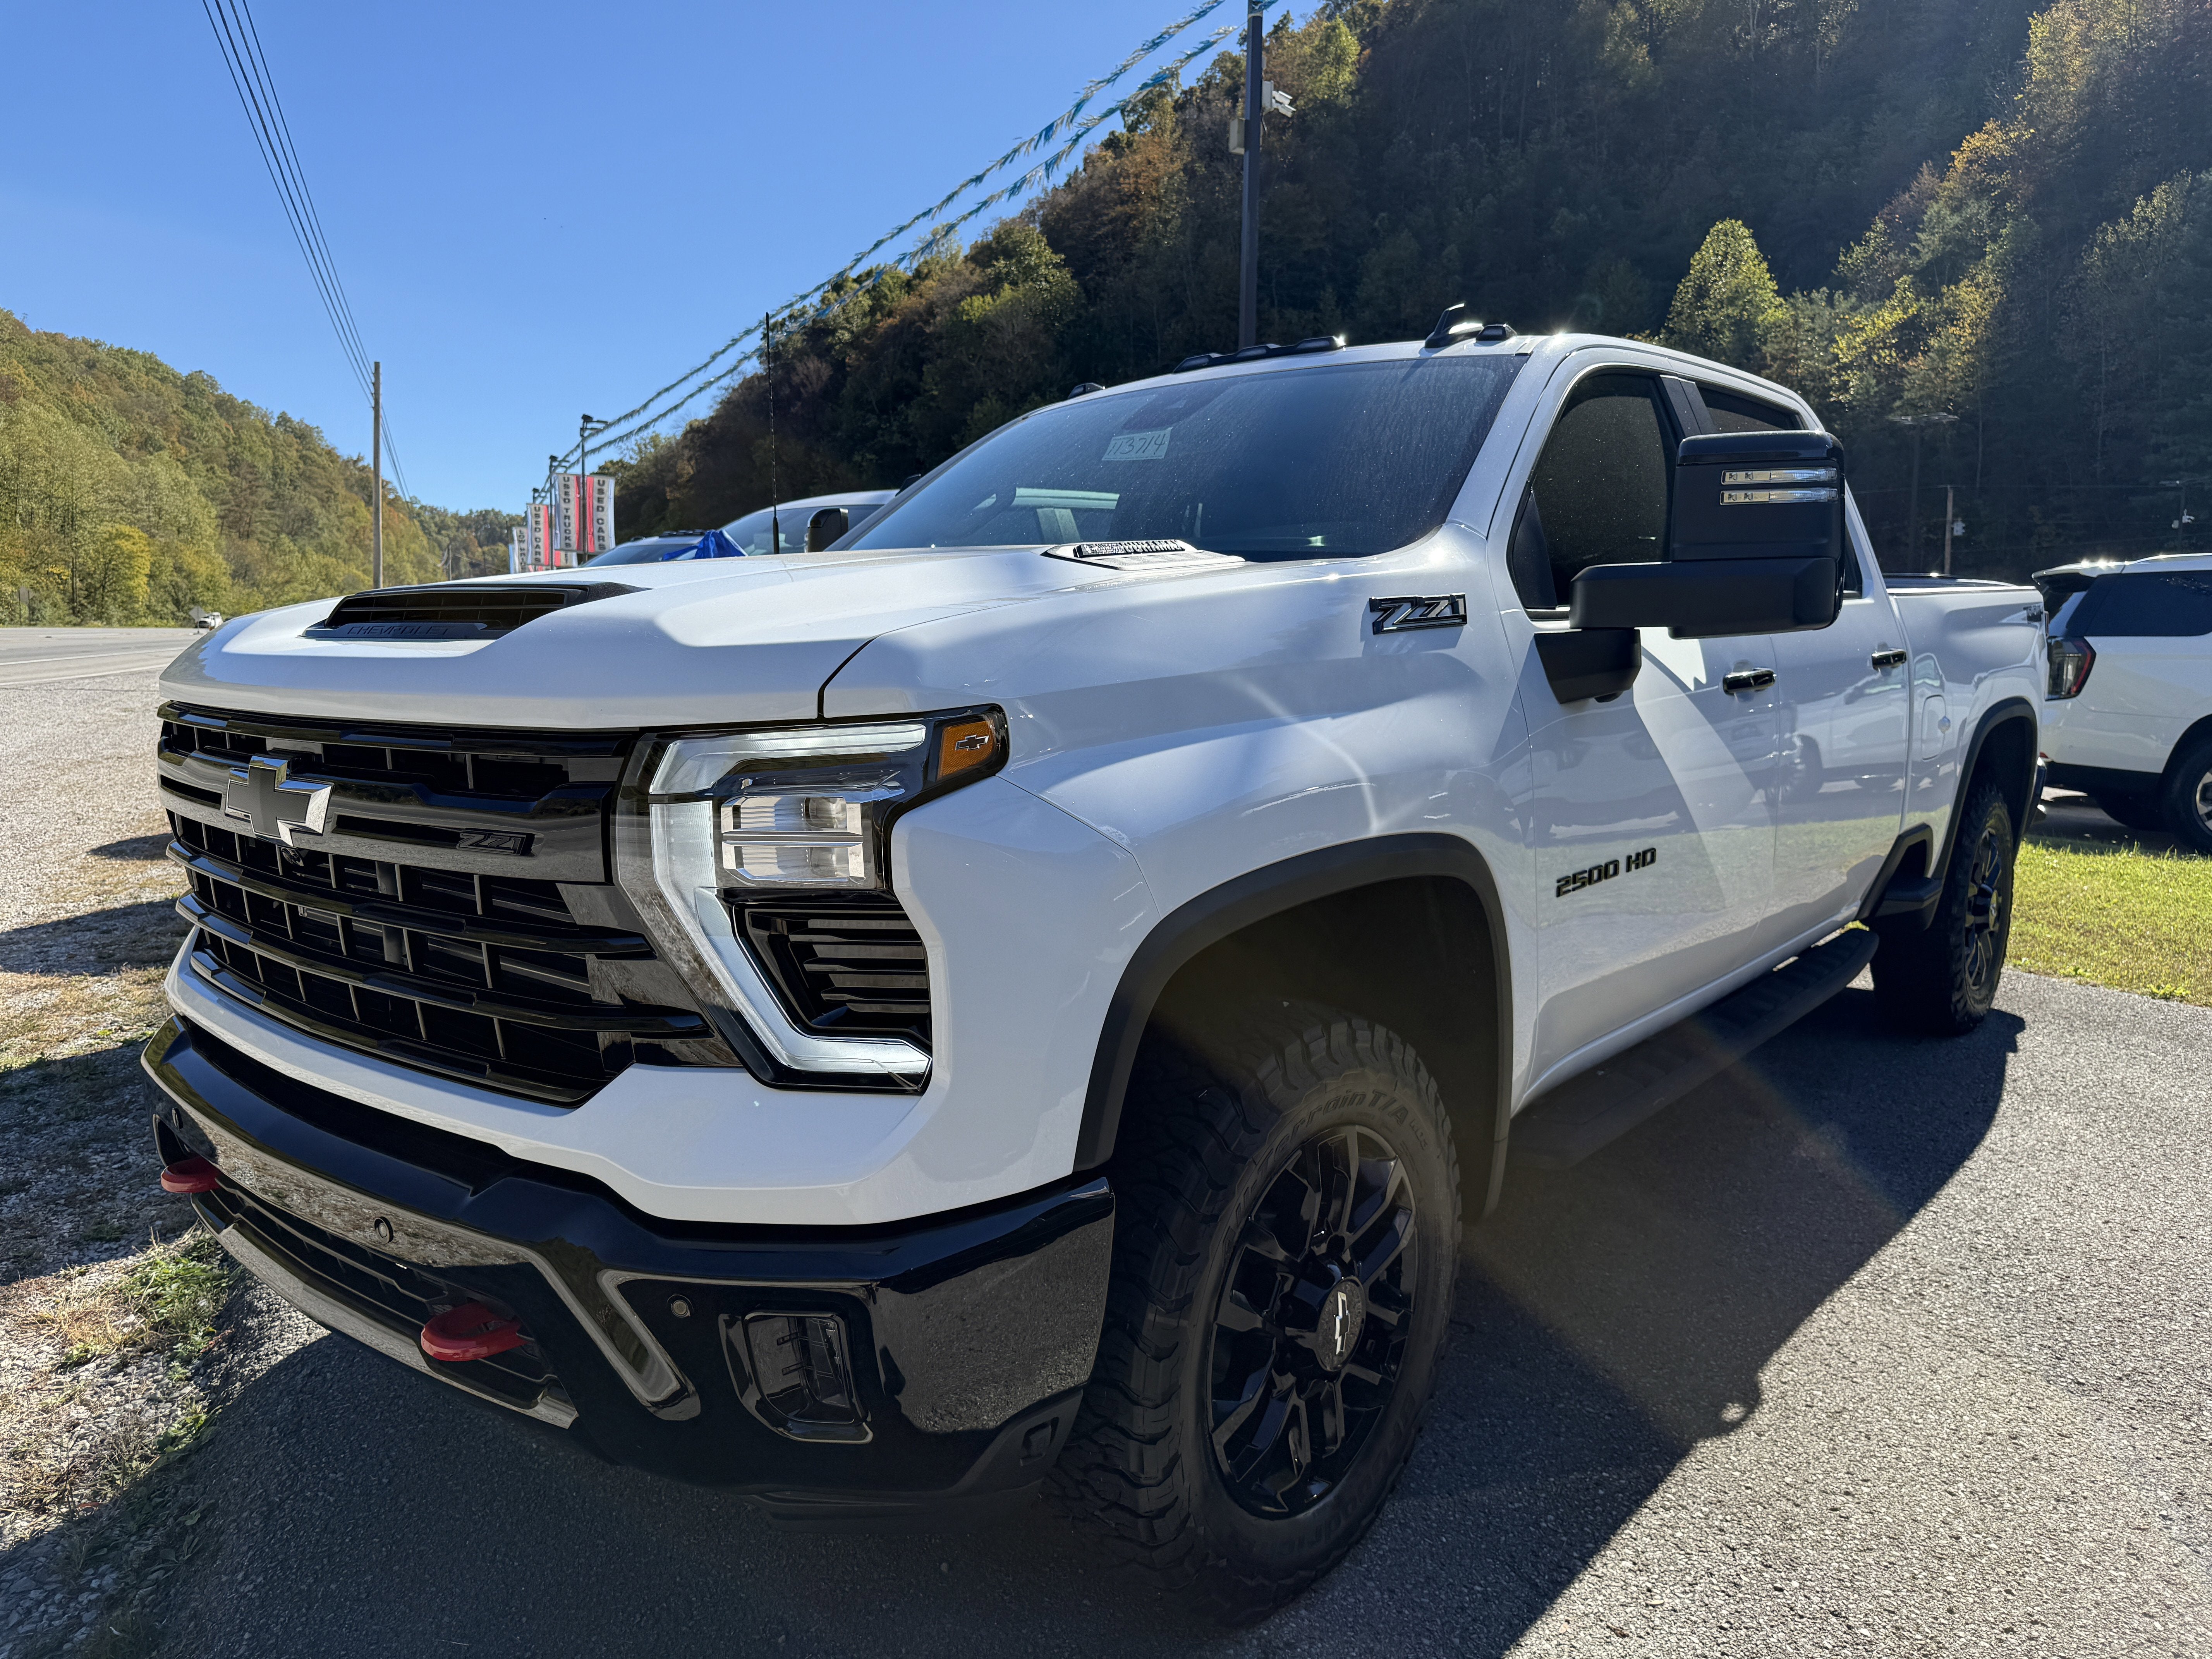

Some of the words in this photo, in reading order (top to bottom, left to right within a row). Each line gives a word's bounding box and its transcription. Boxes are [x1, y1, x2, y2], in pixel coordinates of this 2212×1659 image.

[596, 479, 605, 512] USED
[597, 518, 606, 551] CARS
[347, 625, 451, 635] CHEVROLET
[1369, 592, 1467, 635] Z71
[456, 833, 526, 855] Z71
[1556, 859, 1620, 898] 2500
[1626, 847, 1657, 872] HD
